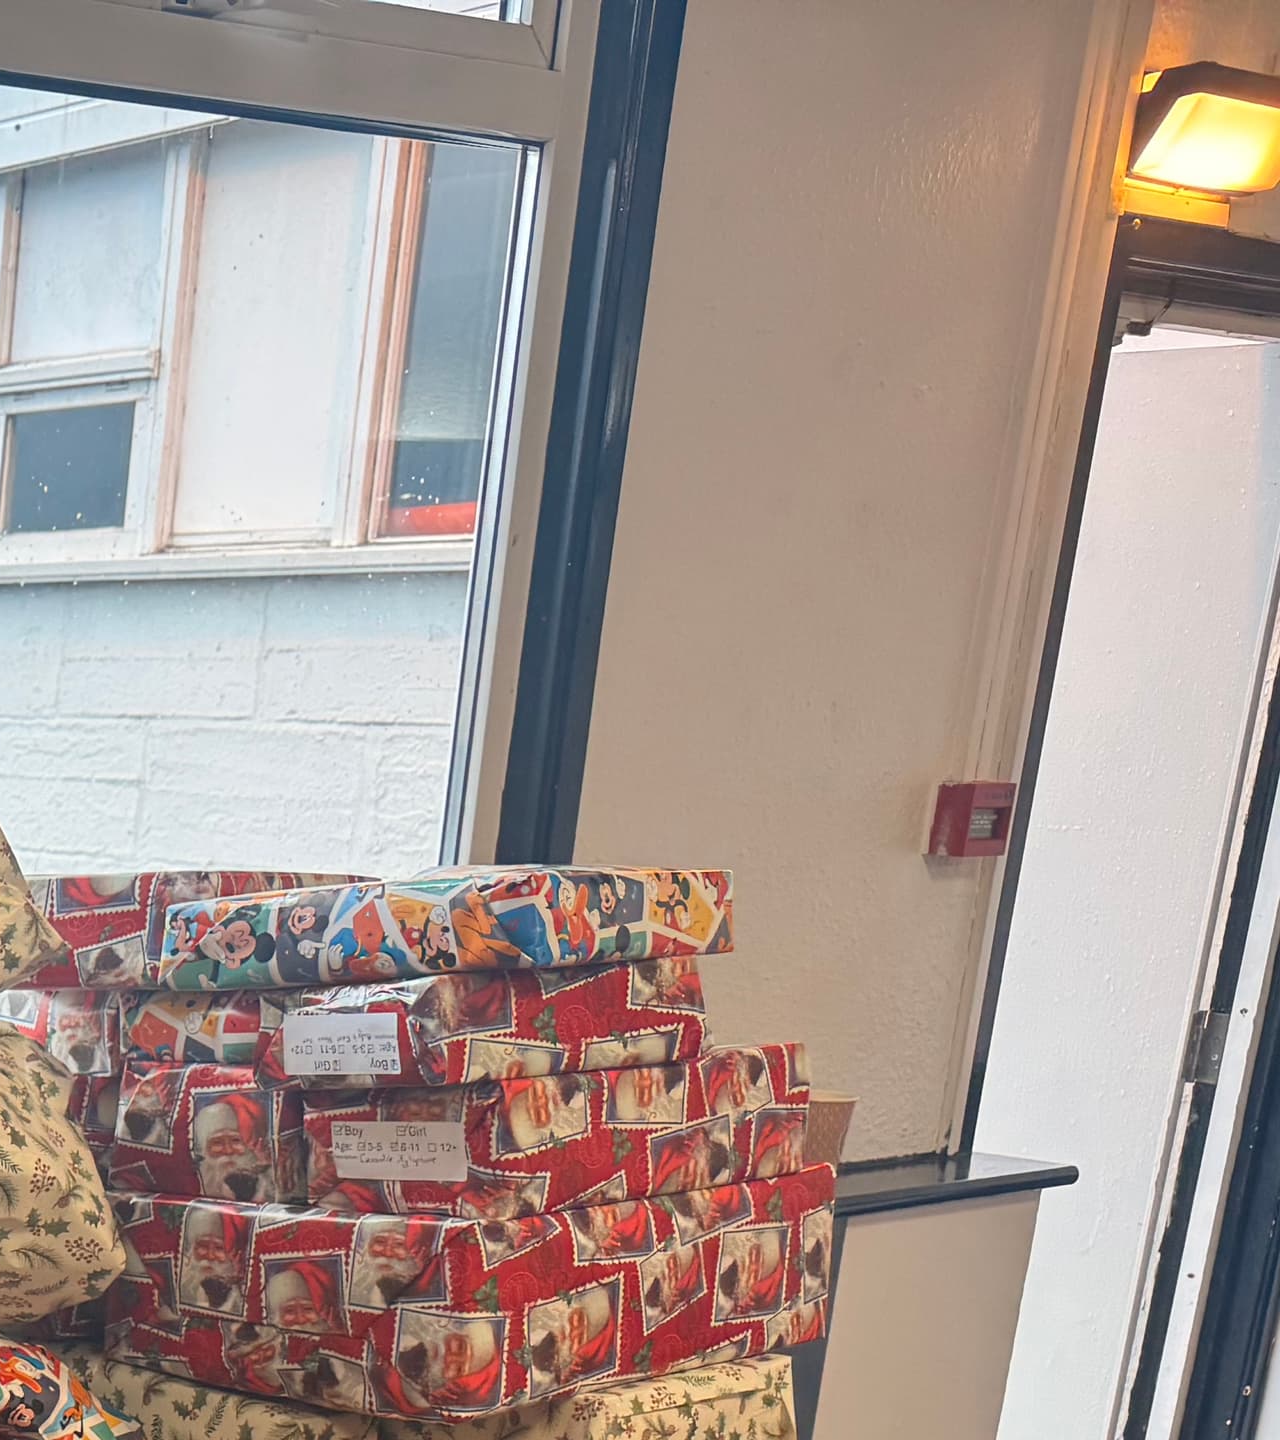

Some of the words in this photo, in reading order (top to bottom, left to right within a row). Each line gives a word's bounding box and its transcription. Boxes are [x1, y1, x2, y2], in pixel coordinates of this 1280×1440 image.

[314, 1059, 332, 1071] Girl
[370, 1059, 389, 1070] Boy
[344, 1125, 363, 1138] Boy
[408, 1125, 427, 1138] Girl
